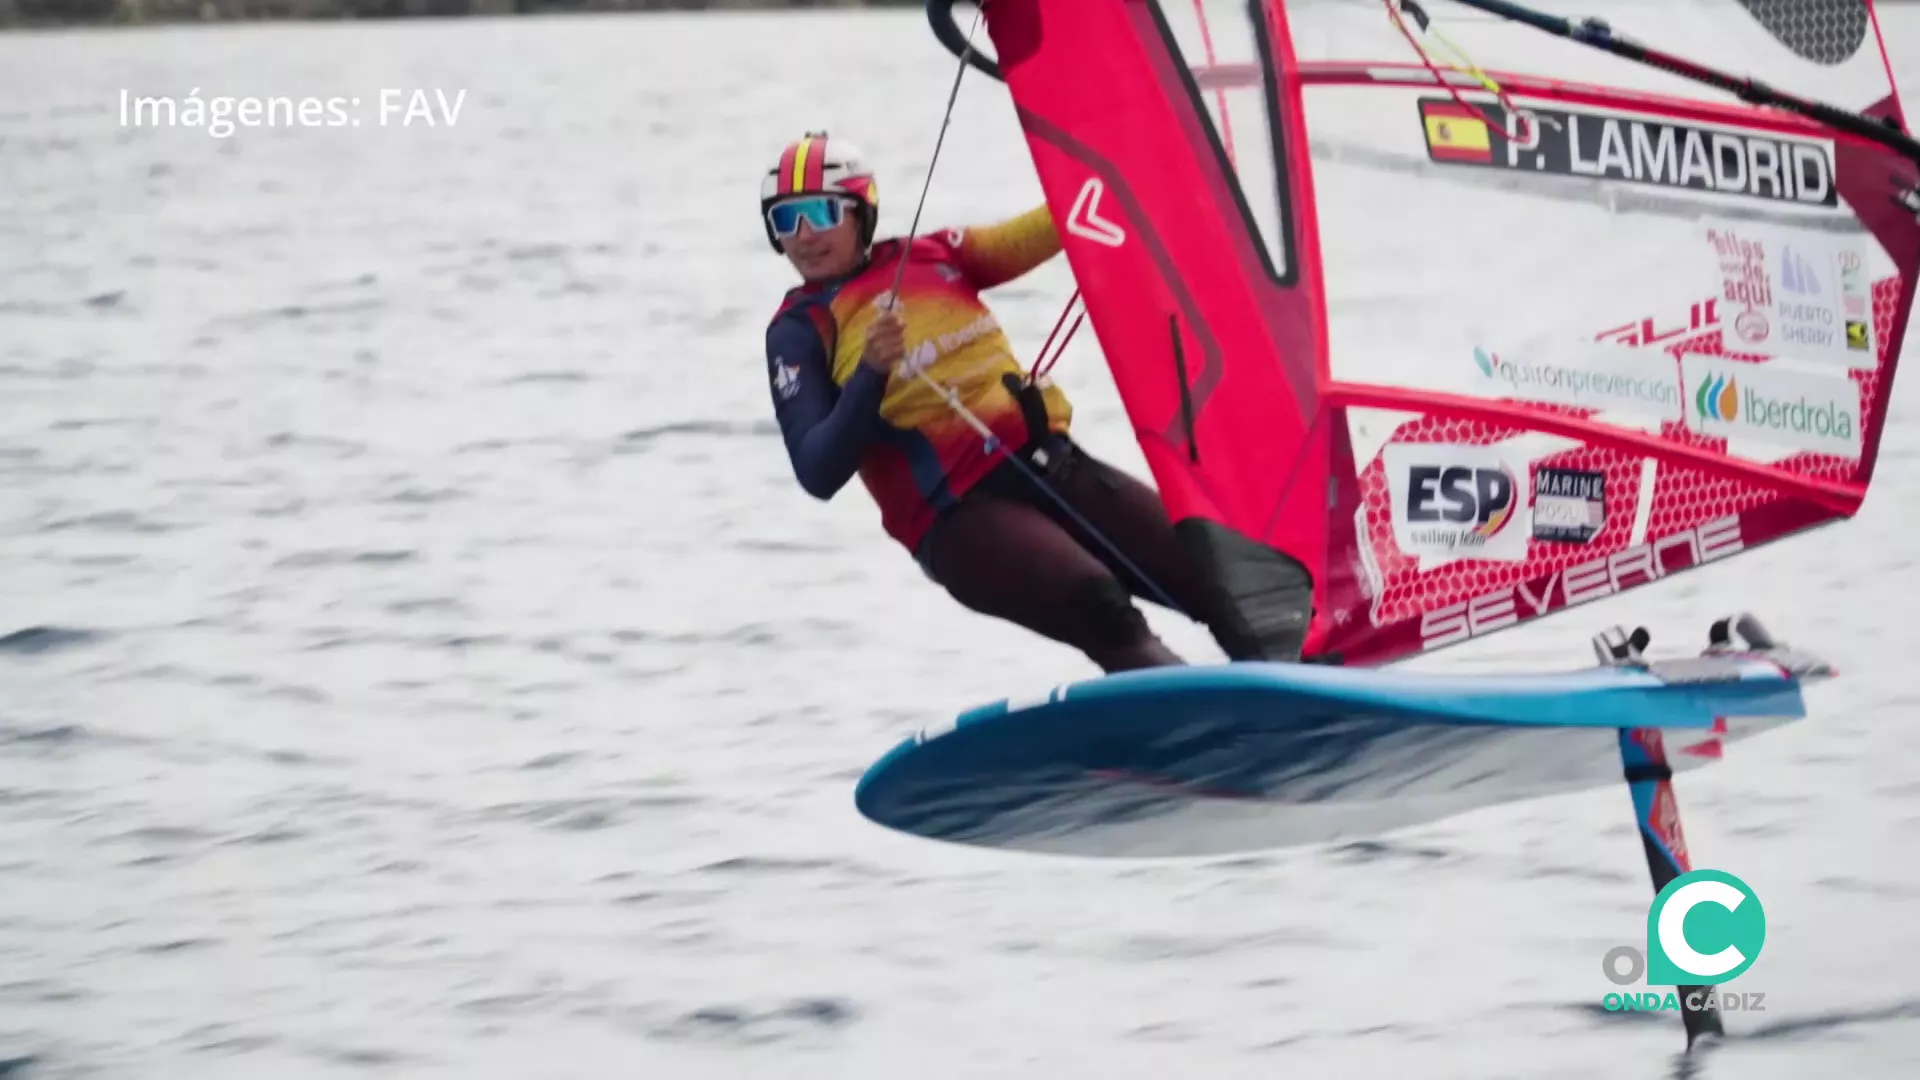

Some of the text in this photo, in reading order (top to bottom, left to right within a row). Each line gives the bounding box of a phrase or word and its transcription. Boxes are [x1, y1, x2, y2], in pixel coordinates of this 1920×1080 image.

[1567, 113, 1830, 203] LAMADRID
[1779, 300, 1833, 326] PUERTO
[1744, 386, 1852, 440] Iberdrola
[1407, 466, 1512, 526] ESP
[1536, 470, 1604, 499] MARINE
[1410, 527, 1487, 548] sailing team
[1420, 514, 1745, 651] SEVERNE
